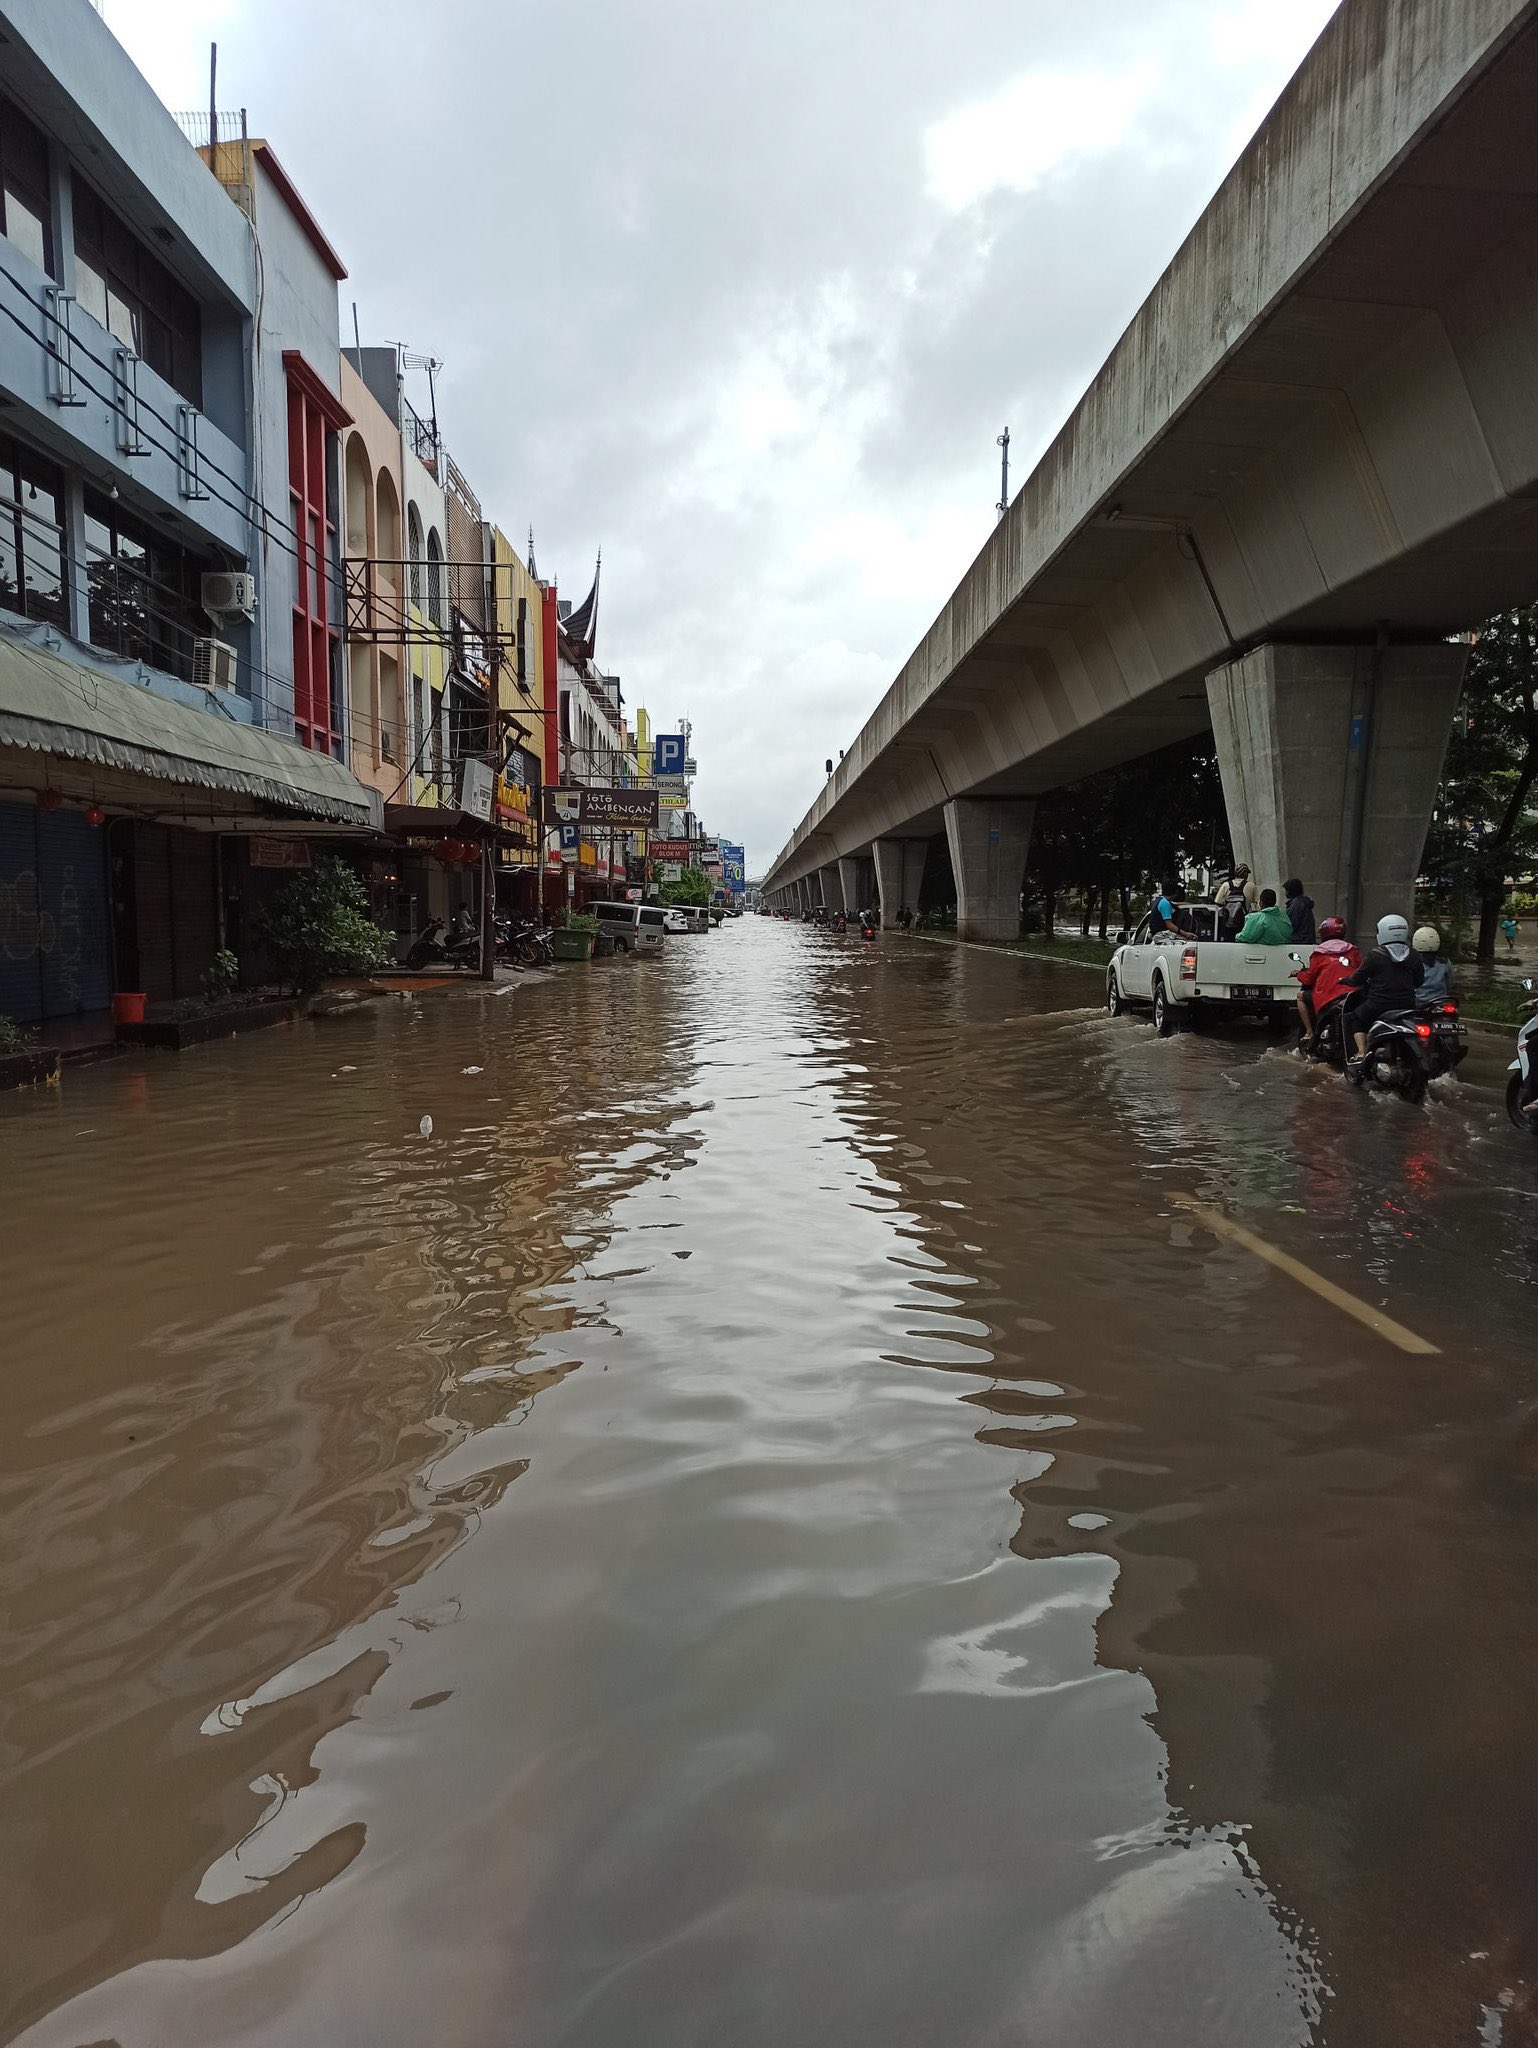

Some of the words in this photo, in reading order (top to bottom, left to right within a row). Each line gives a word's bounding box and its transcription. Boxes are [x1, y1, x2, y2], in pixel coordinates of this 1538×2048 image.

[236, 581, 245, 605] AUX
[661, 740, 679, 768] P
[657, 781, 683, 789] SERONG
[586, 793, 613, 803] SOTO
[586, 803, 652, 815] AMBENGAN
[562, 825, 575, 844] P
[651, 843, 667, 851] SOTO
